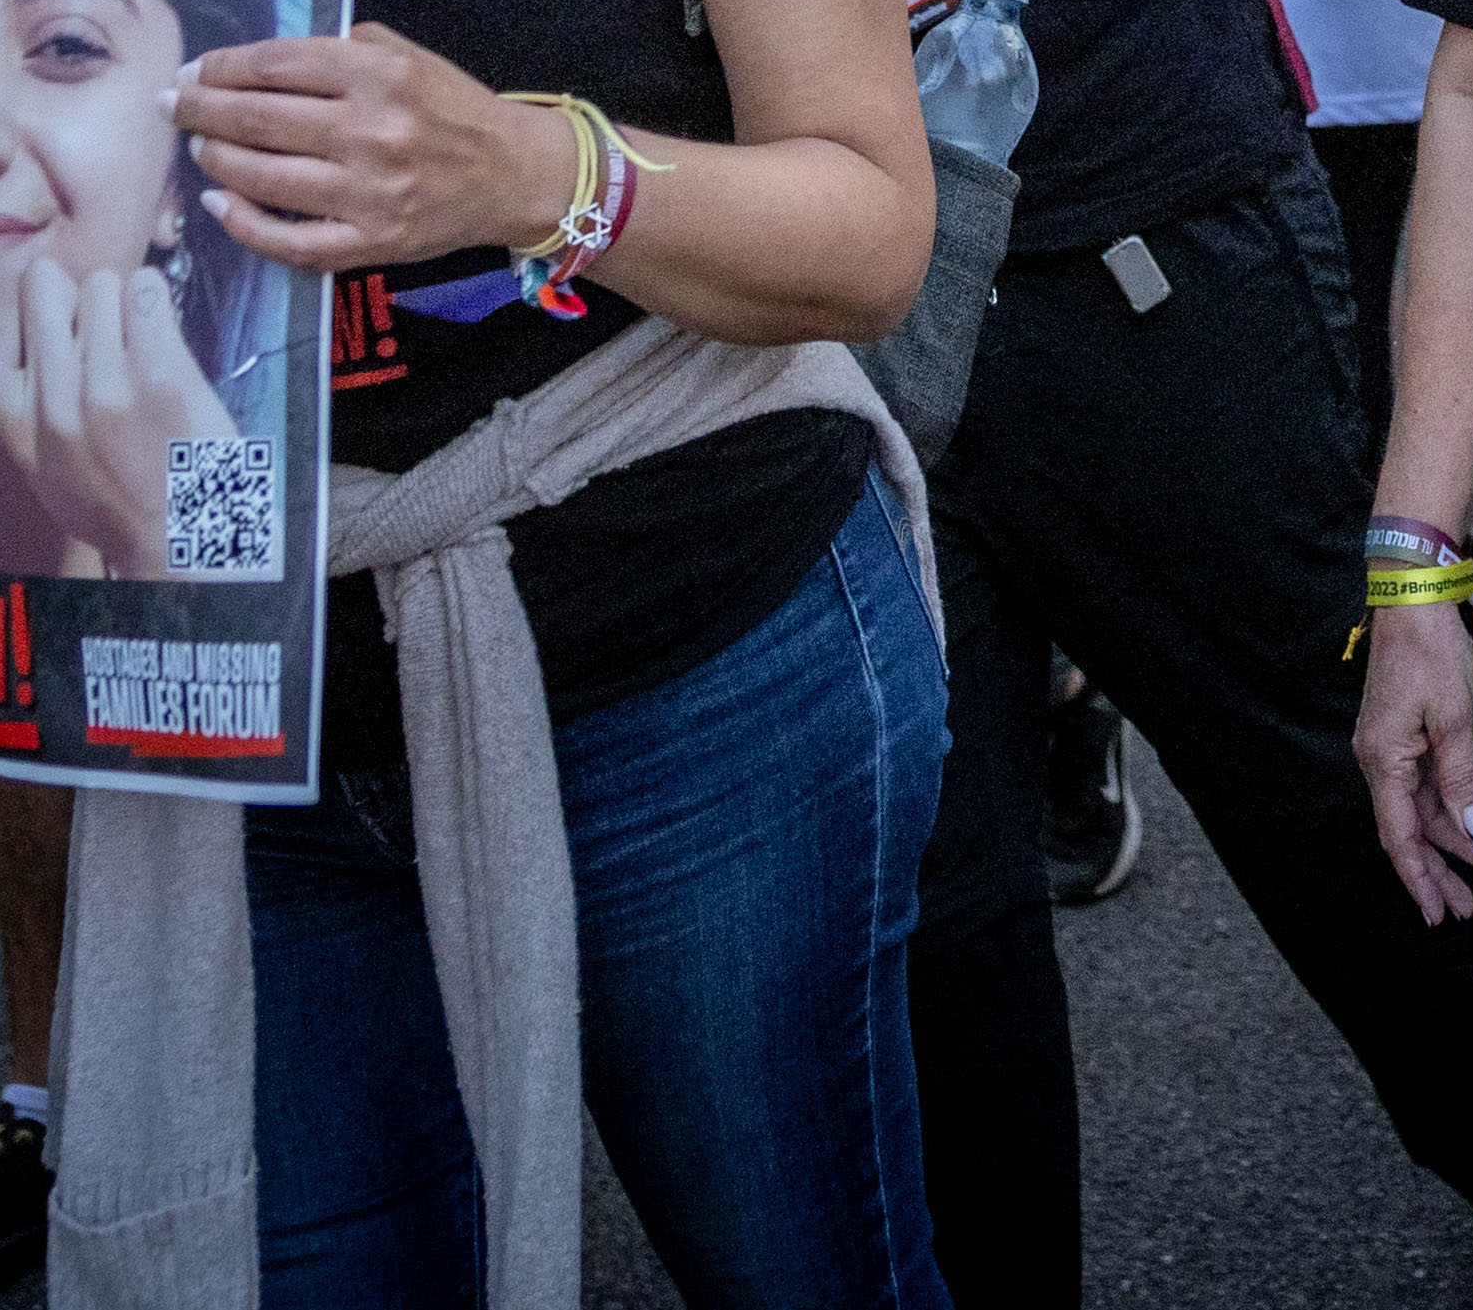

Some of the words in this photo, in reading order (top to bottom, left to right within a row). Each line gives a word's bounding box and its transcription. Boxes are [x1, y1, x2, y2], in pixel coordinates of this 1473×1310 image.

[81, 637, 160, 680] HOSTAGES
[160, 640, 195, 682] AND
[195, 641, 282, 684] MISSING
[86, 675, 184, 736] FAMILIES
[185, 681, 282, 740] FORUM
